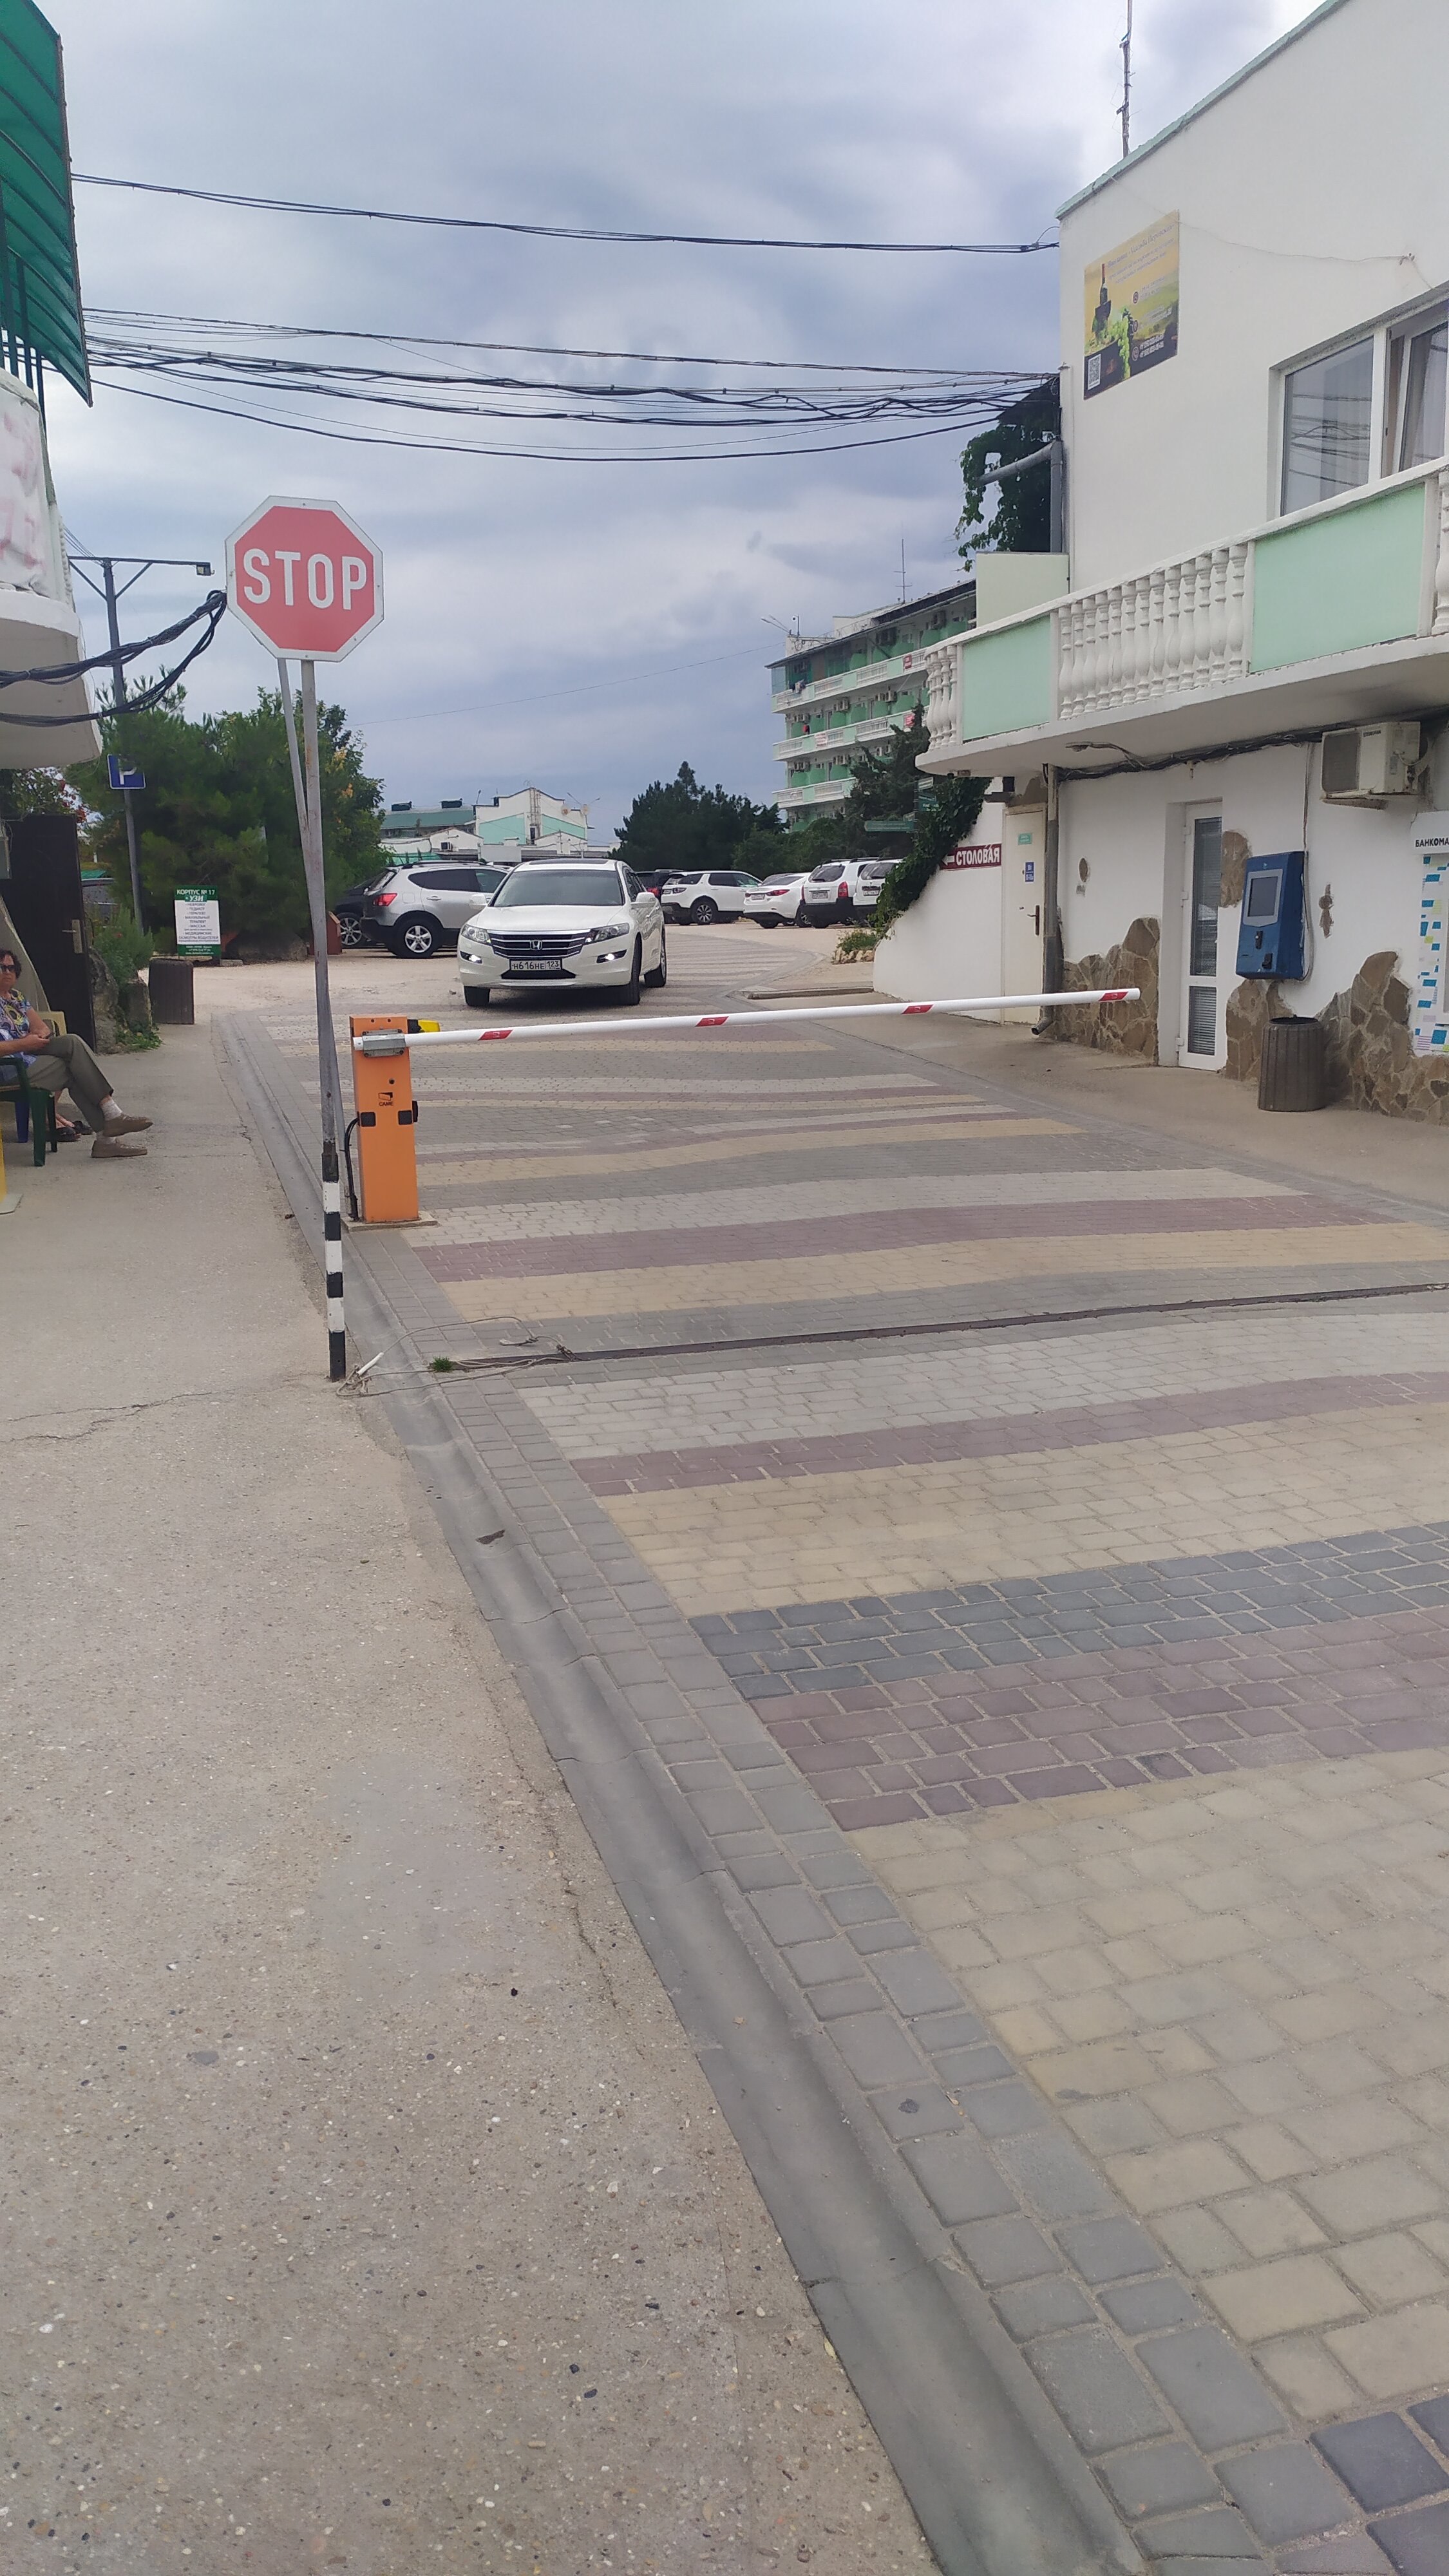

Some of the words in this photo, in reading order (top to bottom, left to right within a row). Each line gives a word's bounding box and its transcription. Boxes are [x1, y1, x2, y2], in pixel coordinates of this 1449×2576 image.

[243, 548, 366, 611] STOP
[956, 847, 999, 866] СТОЛОВАЯ
[513, 961, 545, 970] Н616НЕ
